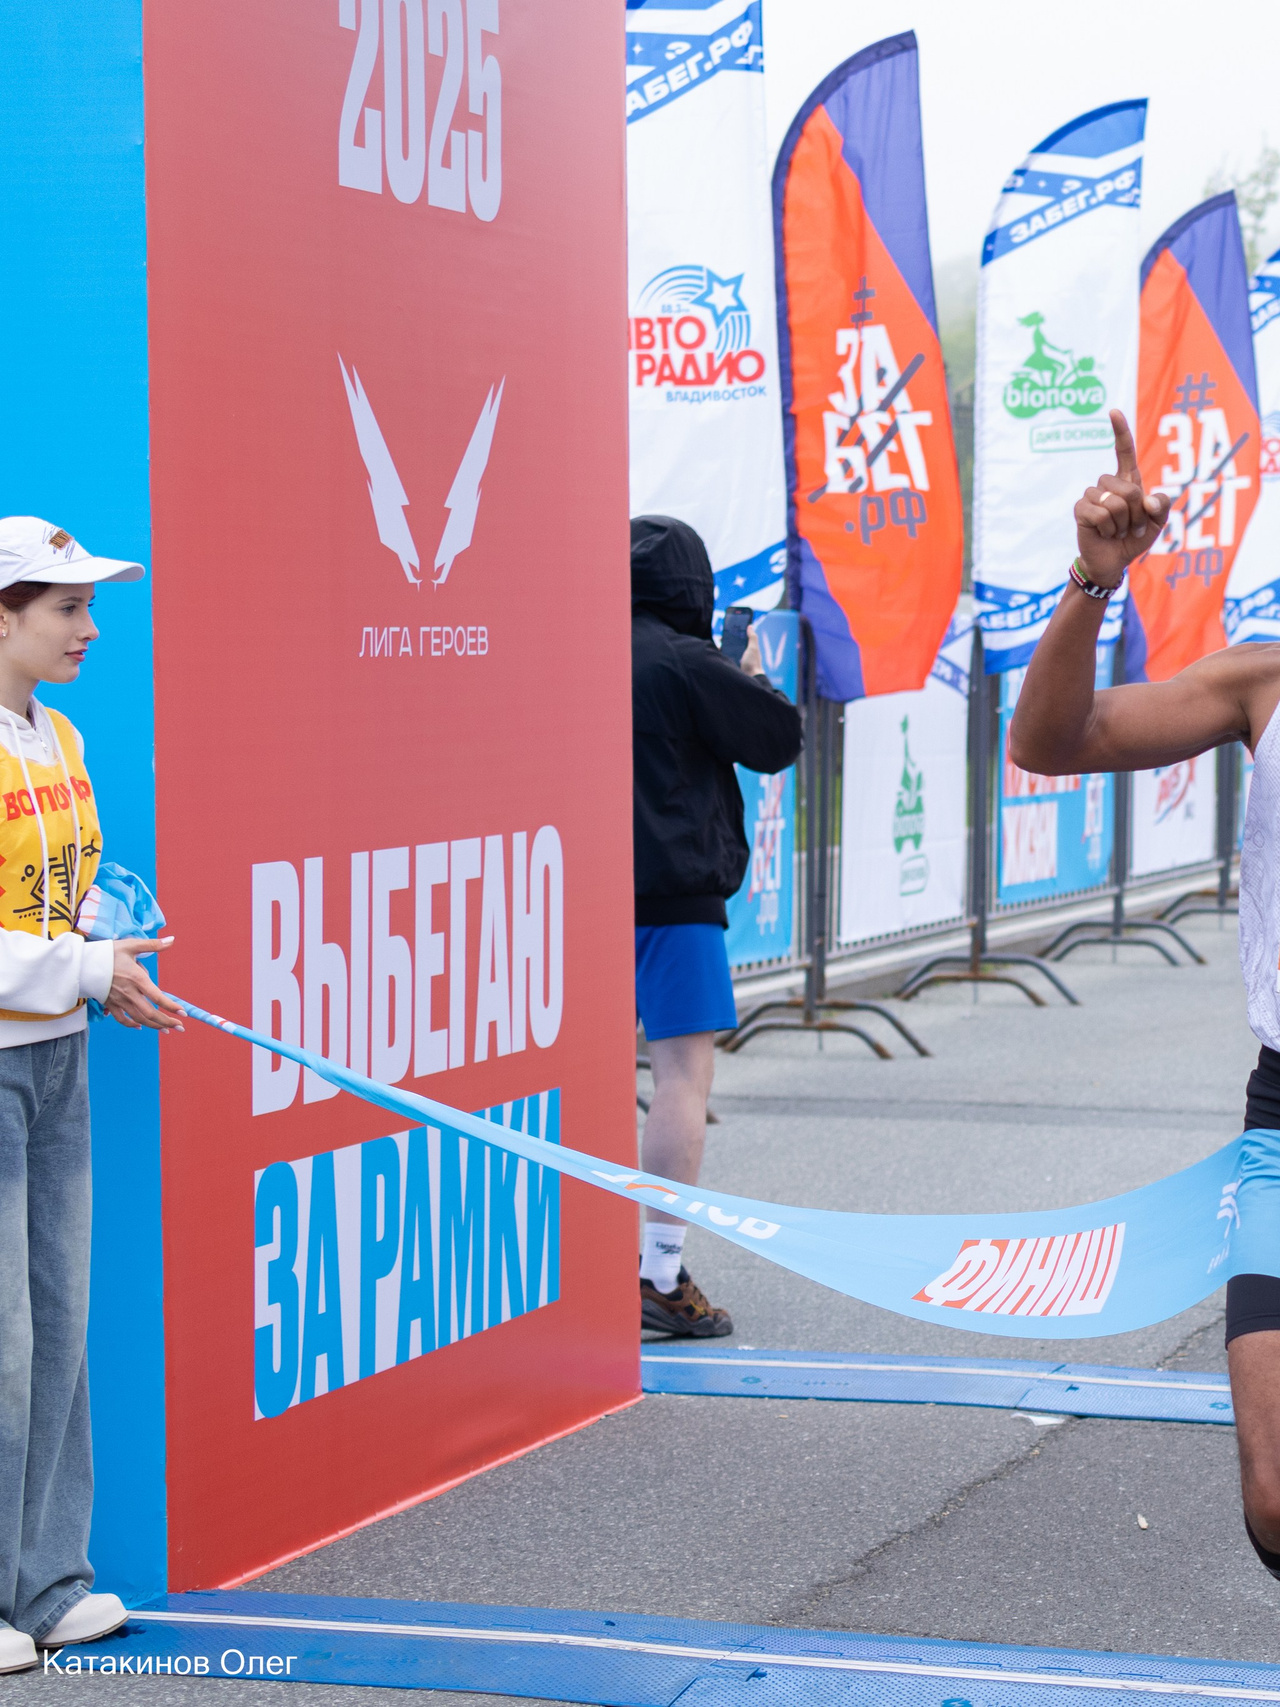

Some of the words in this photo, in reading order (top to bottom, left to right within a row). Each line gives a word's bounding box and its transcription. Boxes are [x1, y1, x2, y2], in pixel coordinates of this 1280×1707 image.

[626, 20, 754, 118] АБЕГ.РФ
[338, 0, 501, 222] 2025
[1009, 169, 1137, 244] ЗАБЕГ.РФ
[628, 315, 707, 351] ВТО
[635, 349, 766, 388] РАДИО
[666, 385, 766, 405] ВЛАДИВОСТОК
[1006, 381, 1104, 408] bionova
[822, 411, 933, 494] БЕГ
[1157, 407, 1238, 488] ЗА
[844, 488, 928, 547] .рф
[359, 626, 412, 658] ЛИГА
[420, 625, 489, 657] ГЕРОЕВ
[252, 825, 564, 1117] ВЫБЕГАЮ
[254, 1150, 345, 1419] ЗА
[359, 1087, 561, 1381] РАМКИ
[912, 1222, 1126, 1317] ФИНИШ
